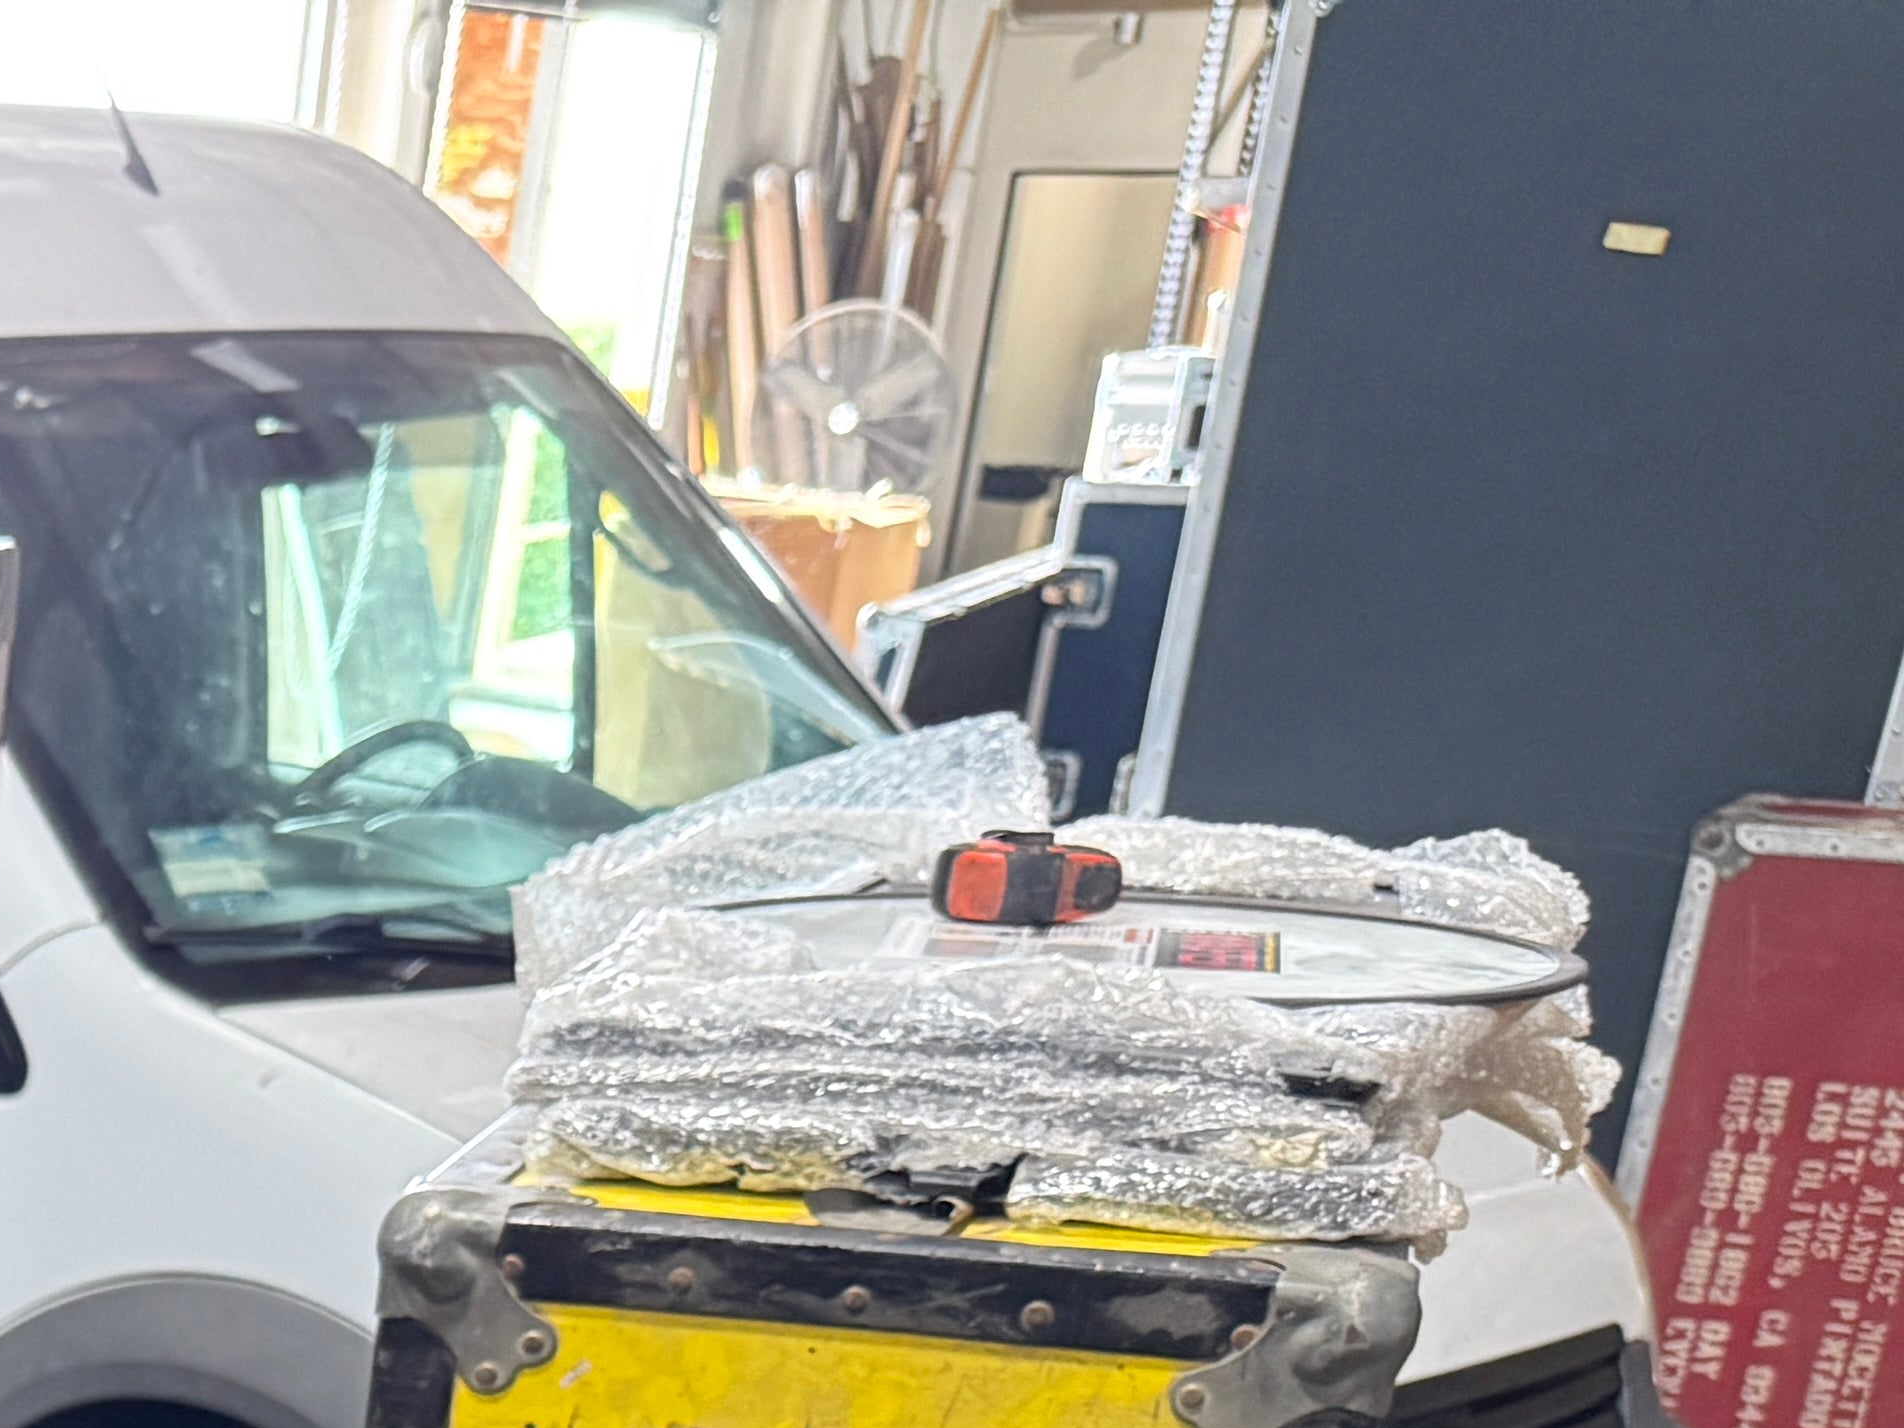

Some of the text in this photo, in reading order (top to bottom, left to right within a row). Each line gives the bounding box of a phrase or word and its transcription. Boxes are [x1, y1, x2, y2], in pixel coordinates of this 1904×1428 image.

[1807, 1082, 1848, 1143] LOS
[1829, 1084, 1882, 1184] SUITE
[1695, 1318, 1732, 1381] DAY
[1753, 1309, 1789, 1349] CA
